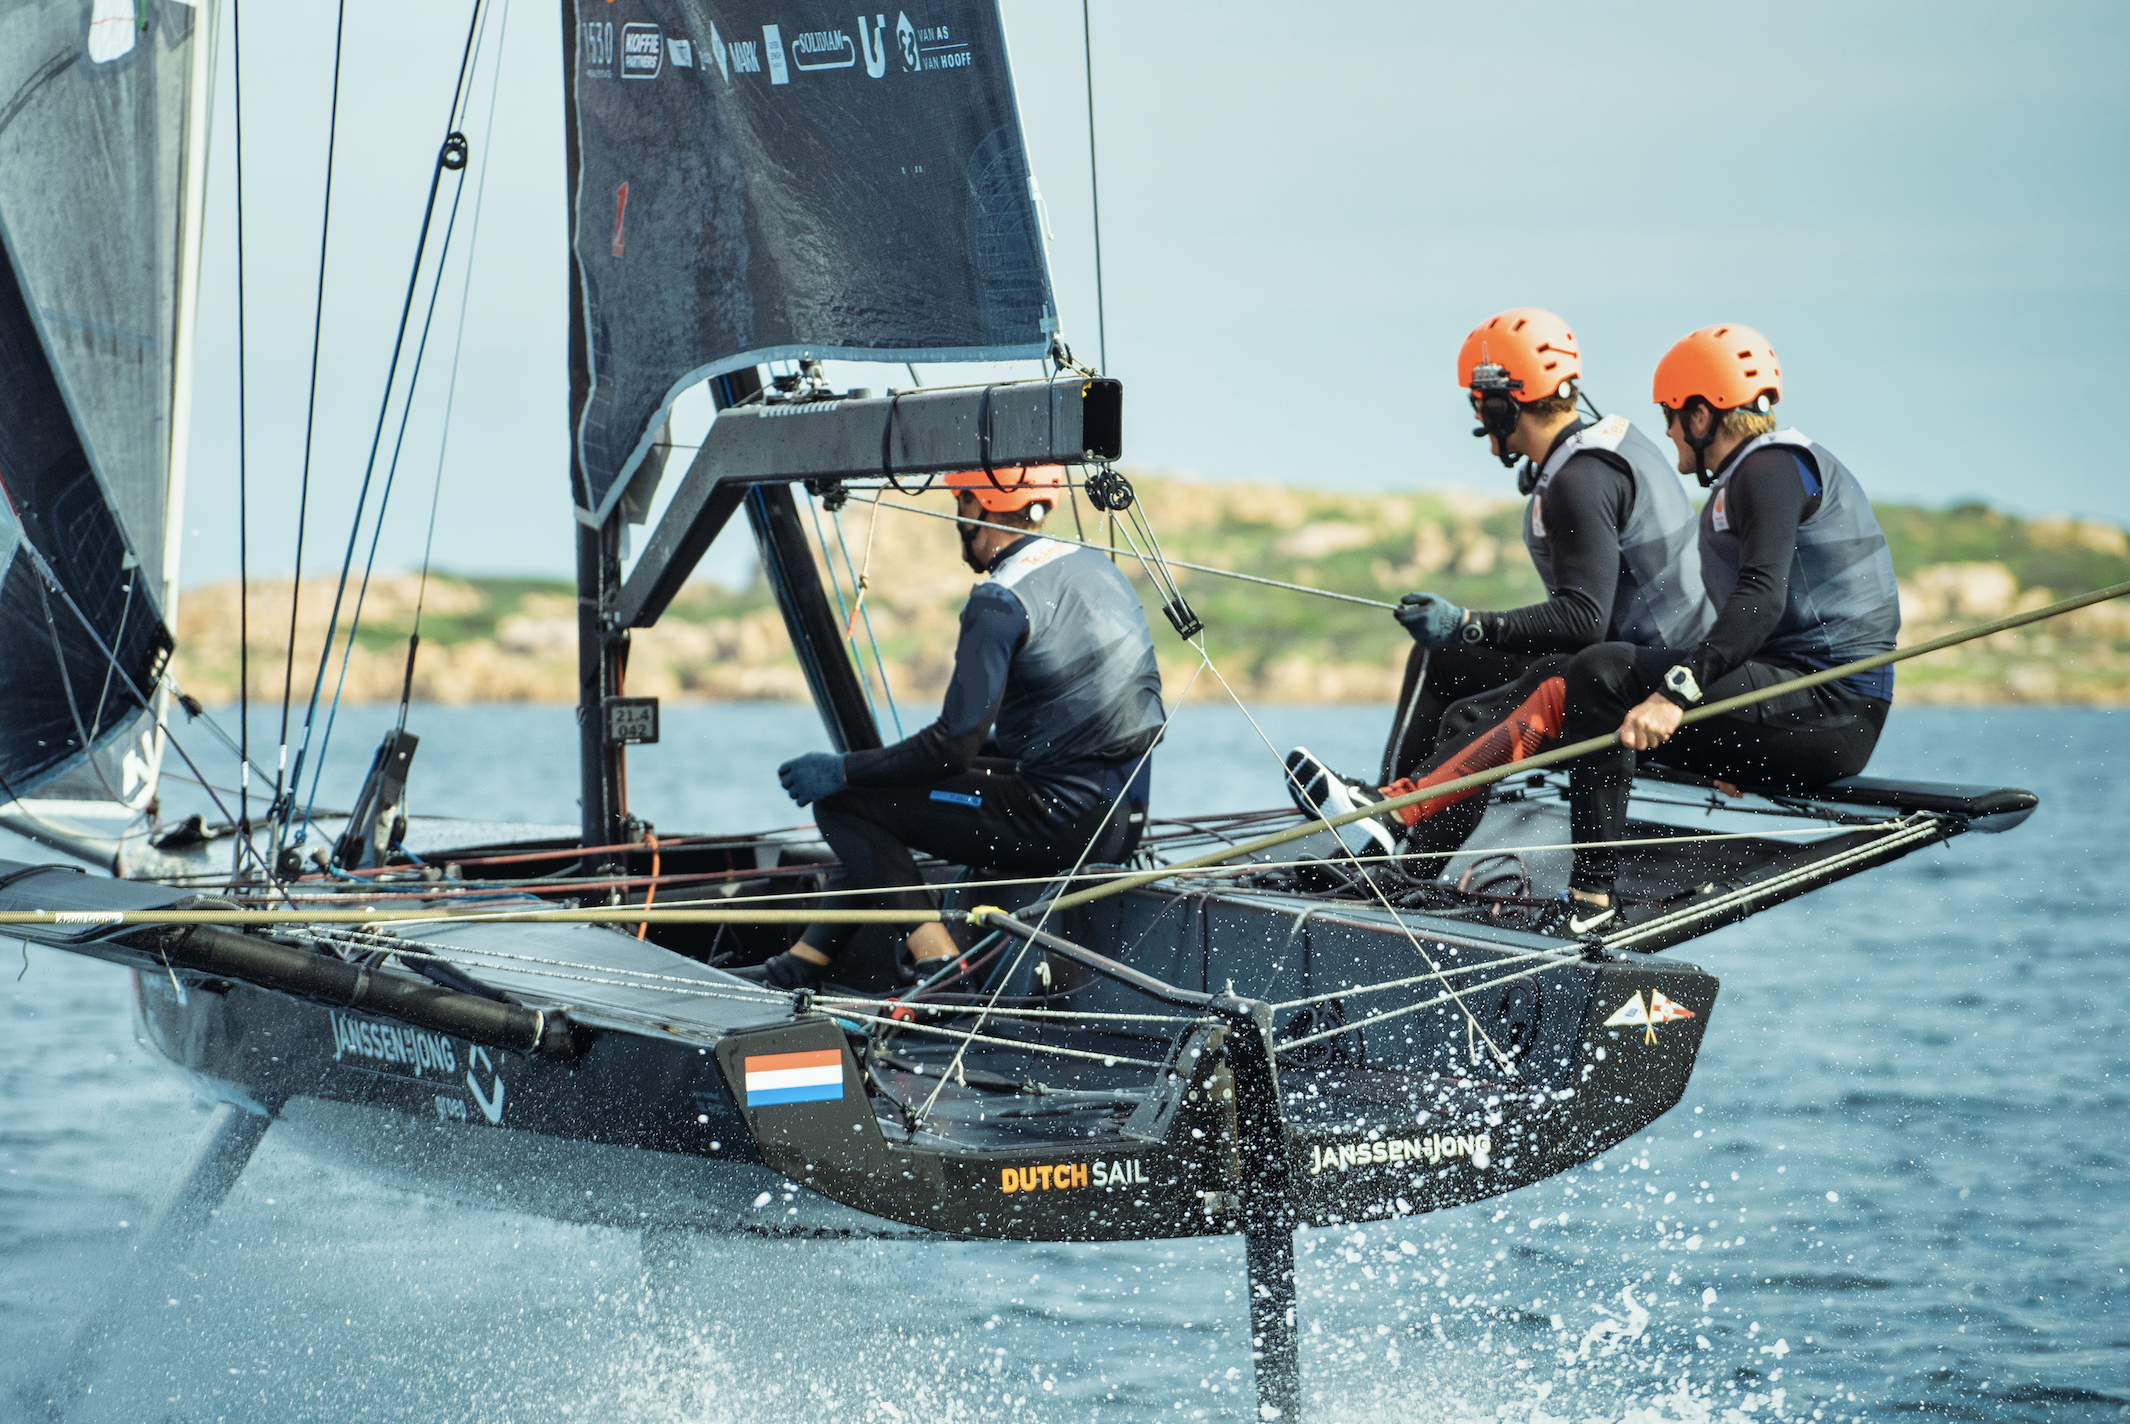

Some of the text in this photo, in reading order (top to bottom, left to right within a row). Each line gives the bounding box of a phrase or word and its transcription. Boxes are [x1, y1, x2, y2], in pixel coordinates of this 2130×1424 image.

[625, 33, 660, 53] KOFFIE
[799, 30, 844, 53] SOLIDIAM
[917, 26, 950, 42] VAN AS
[728, 41, 761, 73] MARK
[922, 52, 971, 70] VAN HOOFF
[1602, 417, 1627, 437] Tea
[330, 1010, 407, 1064] JANSSEN
[410, 1028, 456, 1077] JONG
[1310, 1138, 1421, 1175] JANSSEN
[1430, 1133, 1492, 1165] JONG
[1001, 1159, 1150, 1193] DUTCH SAIL
